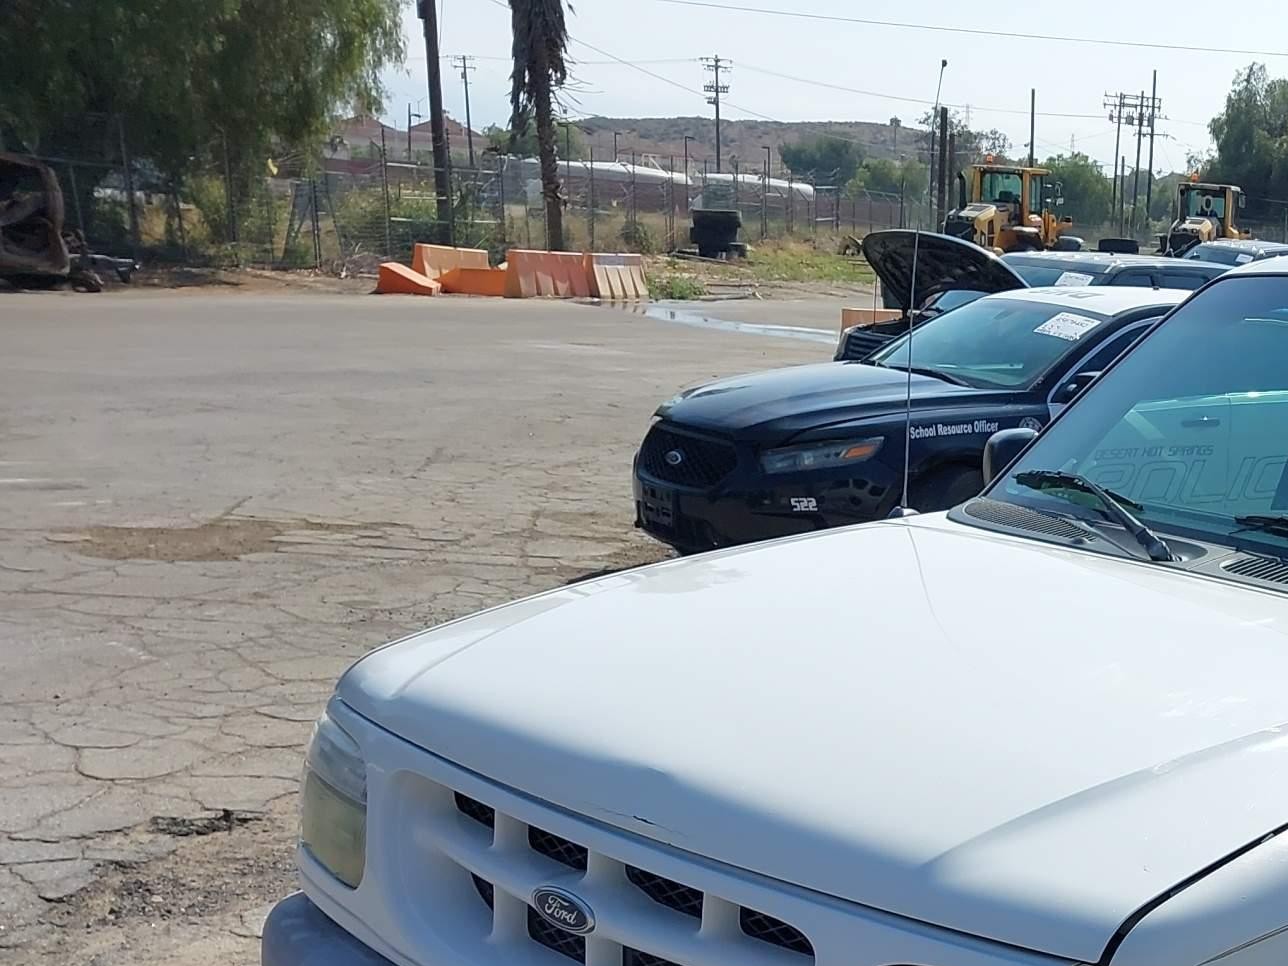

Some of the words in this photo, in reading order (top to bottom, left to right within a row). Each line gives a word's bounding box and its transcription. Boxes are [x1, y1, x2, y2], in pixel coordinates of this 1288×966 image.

[910, 424, 936, 439] School
[937, 423, 972, 436] Resource
[974, 420, 999, 433] Officer
[1095, 448, 1139, 460] DESERT
[1141, 446, 1164, 457] HOT
[1167, 445, 1215, 457] SPRINGS
[1088, 455, 1288, 504] POLIC
[790, 497, 818, 511] 522
[545, 895, 578, 925] Ford
